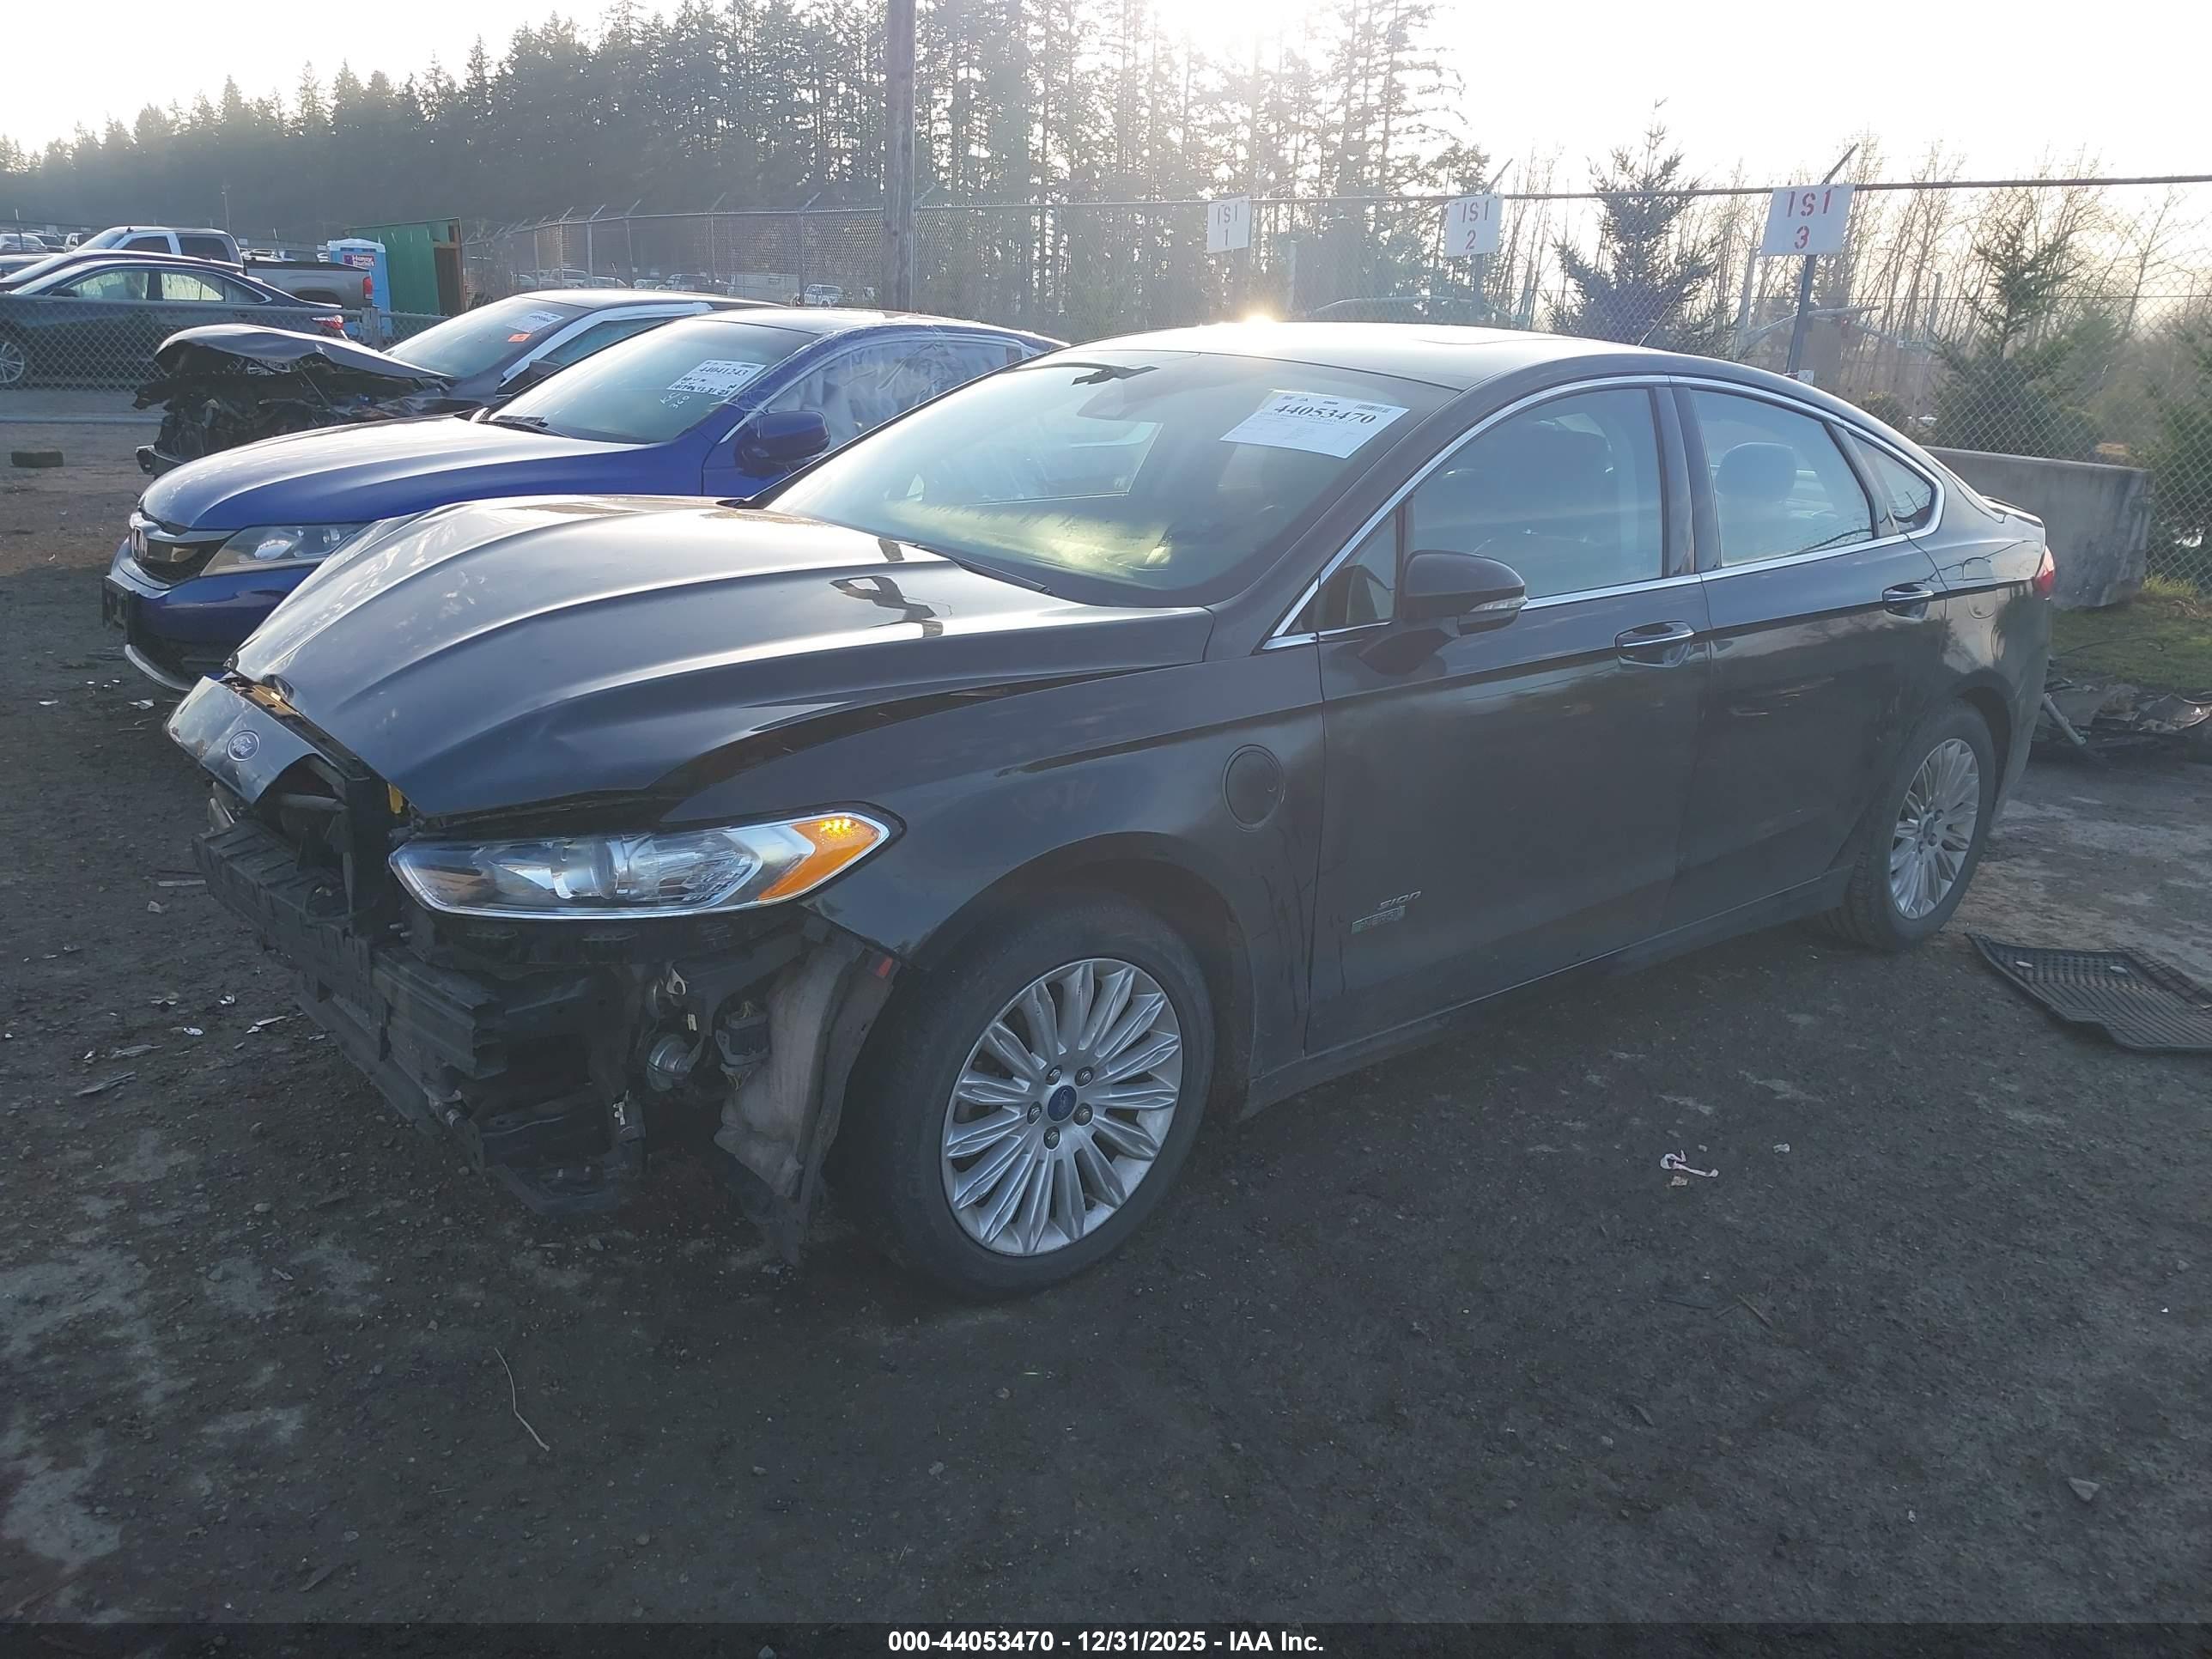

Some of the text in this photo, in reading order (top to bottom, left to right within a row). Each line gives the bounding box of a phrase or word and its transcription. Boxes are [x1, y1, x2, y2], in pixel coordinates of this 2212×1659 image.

[1224, 228, 1229, 247] 1
[1465, 229, 1476, 250] 2
[1794, 225, 1810, 249] 3
[699, 367, 749, 376] 44041243
[1274, 404, 1377, 424] 44053470
